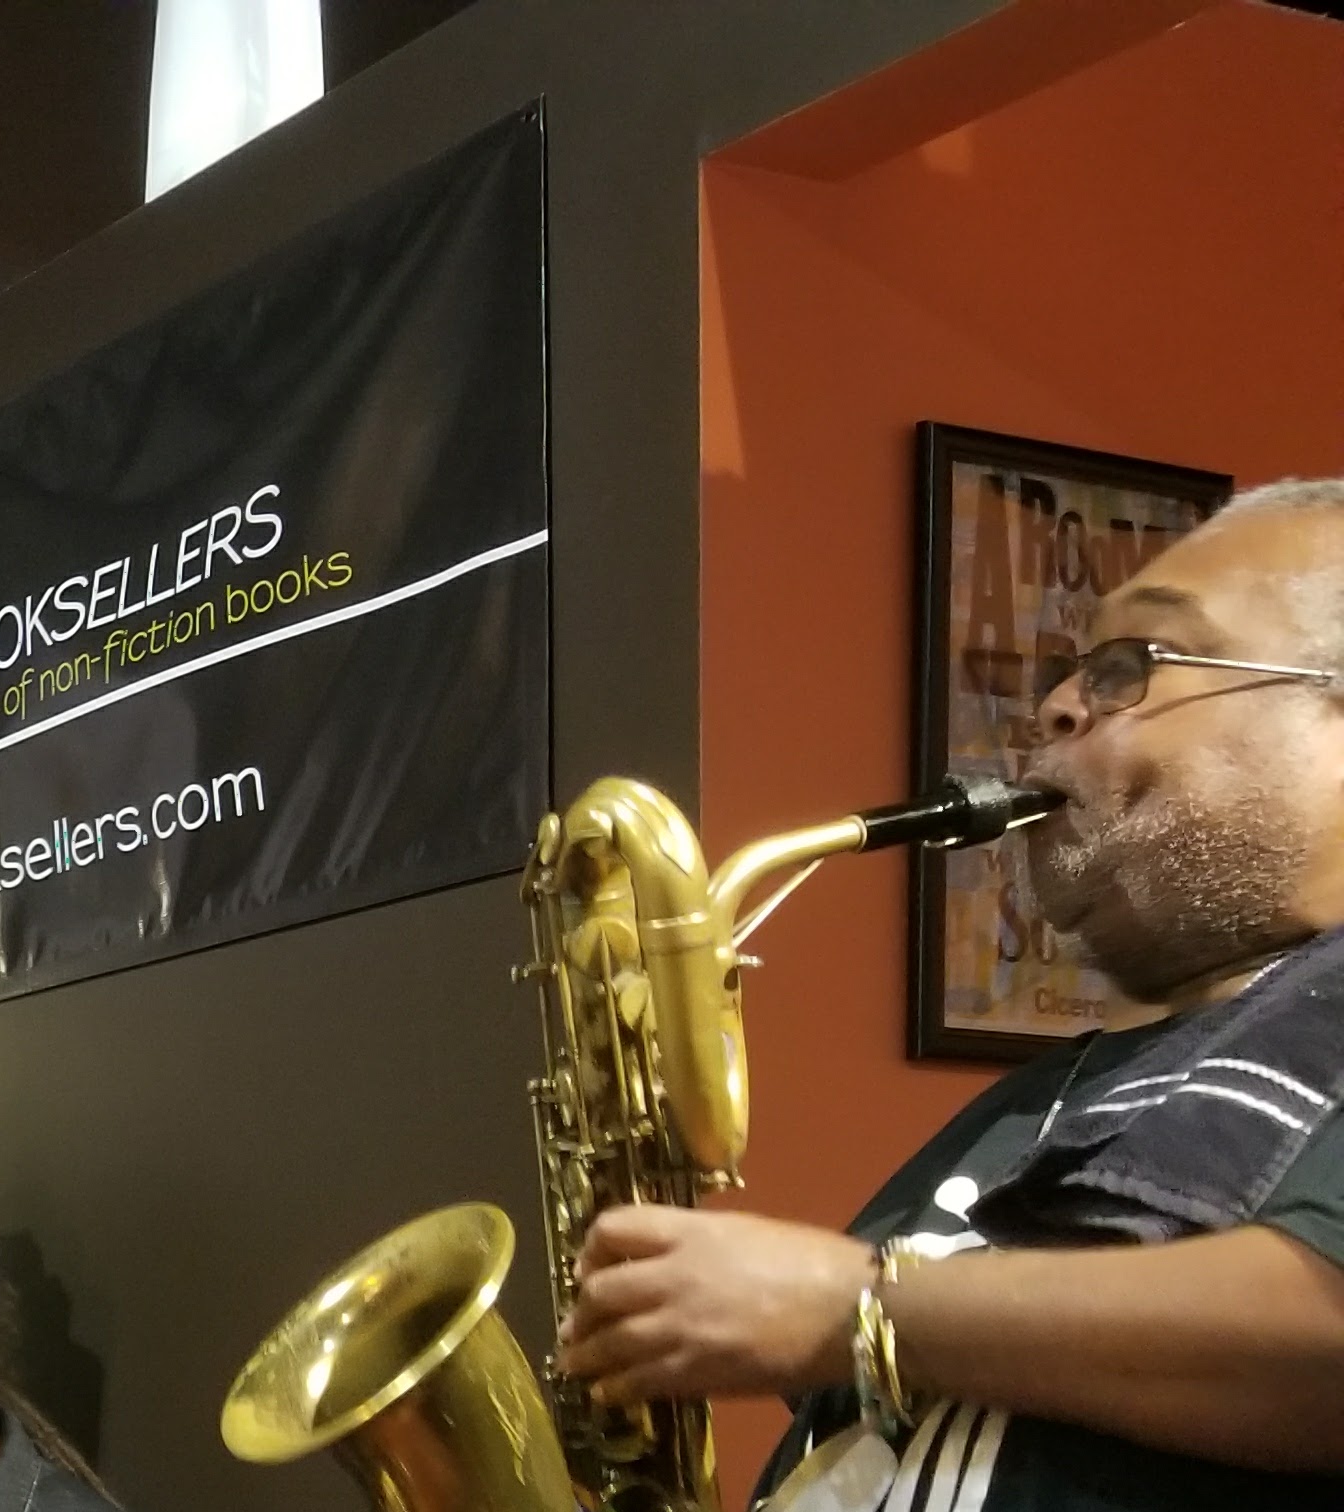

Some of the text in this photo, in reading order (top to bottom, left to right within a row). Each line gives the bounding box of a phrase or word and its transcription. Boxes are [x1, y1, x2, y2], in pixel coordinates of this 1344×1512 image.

[2, 668, 36, 722] of
[37, 598, 217, 702] non-fiction
[223, 548, 356, 626] books
